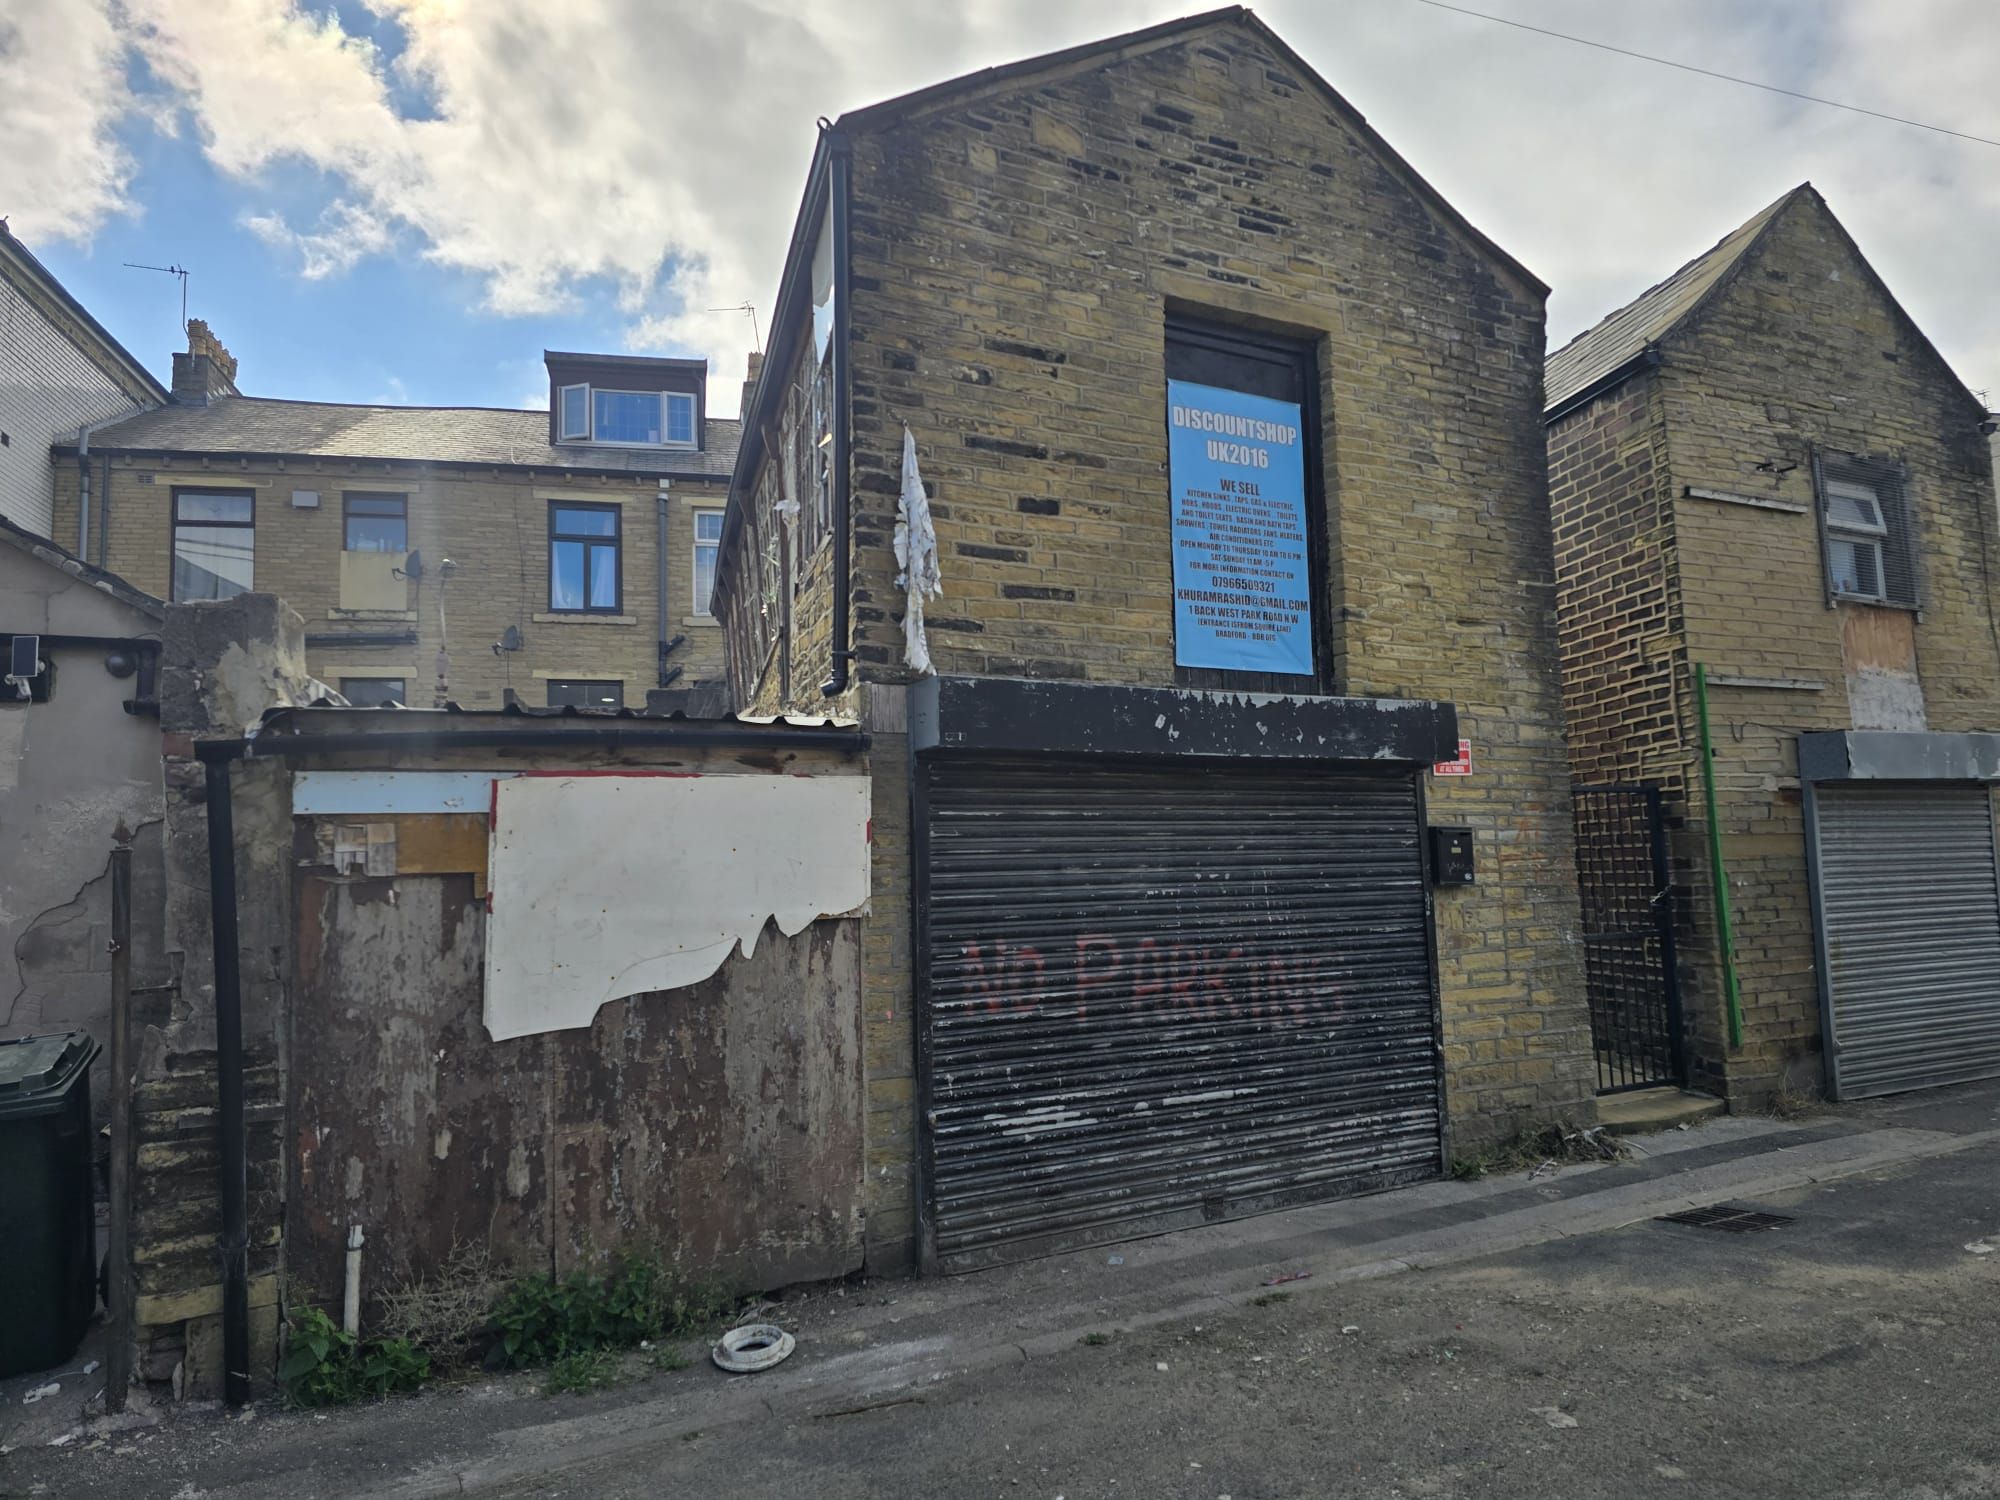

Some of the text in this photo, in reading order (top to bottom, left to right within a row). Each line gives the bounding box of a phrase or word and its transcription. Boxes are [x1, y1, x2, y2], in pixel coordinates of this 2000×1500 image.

[1173, 406, 1297, 445] DISCOUNTSHOP
[1207, 440, 1269, 469] UK2016
[1220, 479, 1260, 496] WE SELL
[1180, 539, 1196, 548] OPEN
[1197, 541, 1222, 551] MONDAY
[1222, 544, 1231, 552] TO
[1231, 545, 1261, 556] THURSDAY
[1269, 550, 1279, 559] AM
[1189, 561, 1201, 570] FOR
[1202, 562, 1219, 571] MORE
[1219, 564, 1259, 577] INFORMATION
[1259, 568, 1286, 579] CONTACT
[1177, 588, 1309, 612] KHURAMRASHID@GMAIL.COM
[1194, 605, 1217, 617] BACK
[1217, 607, 1240, 619] WEST
[1241, 609, 1262, 621] PARK
[1262, 611, 1283, 623] ROAD
[1215, 630, 1247, 640] BRADFORD
[962, 935, 1047, 1018] NO
